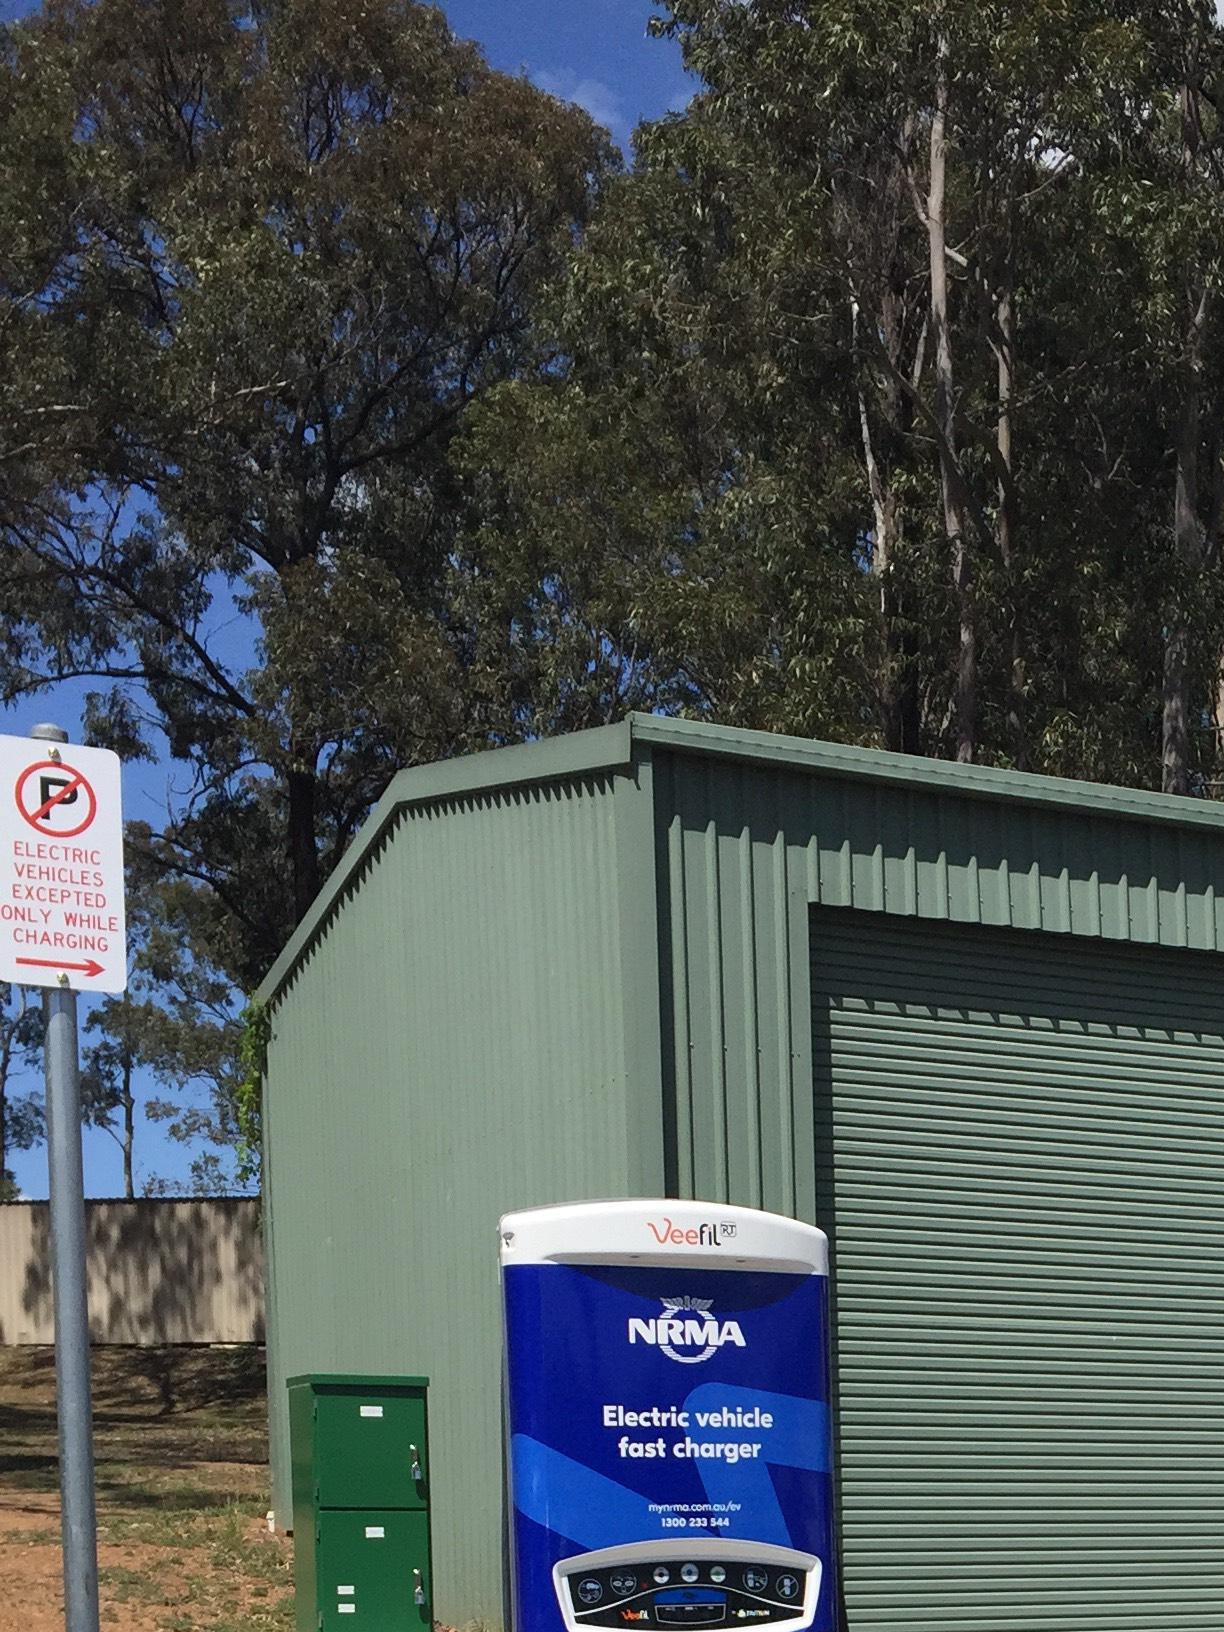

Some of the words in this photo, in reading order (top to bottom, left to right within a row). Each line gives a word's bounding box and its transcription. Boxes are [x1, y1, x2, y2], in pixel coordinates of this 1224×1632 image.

[13, 841, 101, 865] ELECTRIC
[14, 862, 104, 887] VEHICLES
[12, 884, 106, 908] EXCEPTED
[1, 904, 52, 924] ONLY
[64, 911, 118, 932] WHILE
[13, 928, 108, 952] CHARGING
[646, 1217, 721, 1246] Veefil
[628, 1318, 747, 1347] NRMA
[603, 1405, 689, 1428] Electric
[696, 1407, 774, 1429] vehicle
[618, 1437, 666, 1458] fast
[673, 1438, 761, 1463] charger
[648, 1500, 741, 1514] mynrma.com.au/ev
[661, 1517, 687, 1527] 1300
[689, 1517, 708, 1527] 233
[710, 1517, 730, 1527] 544
